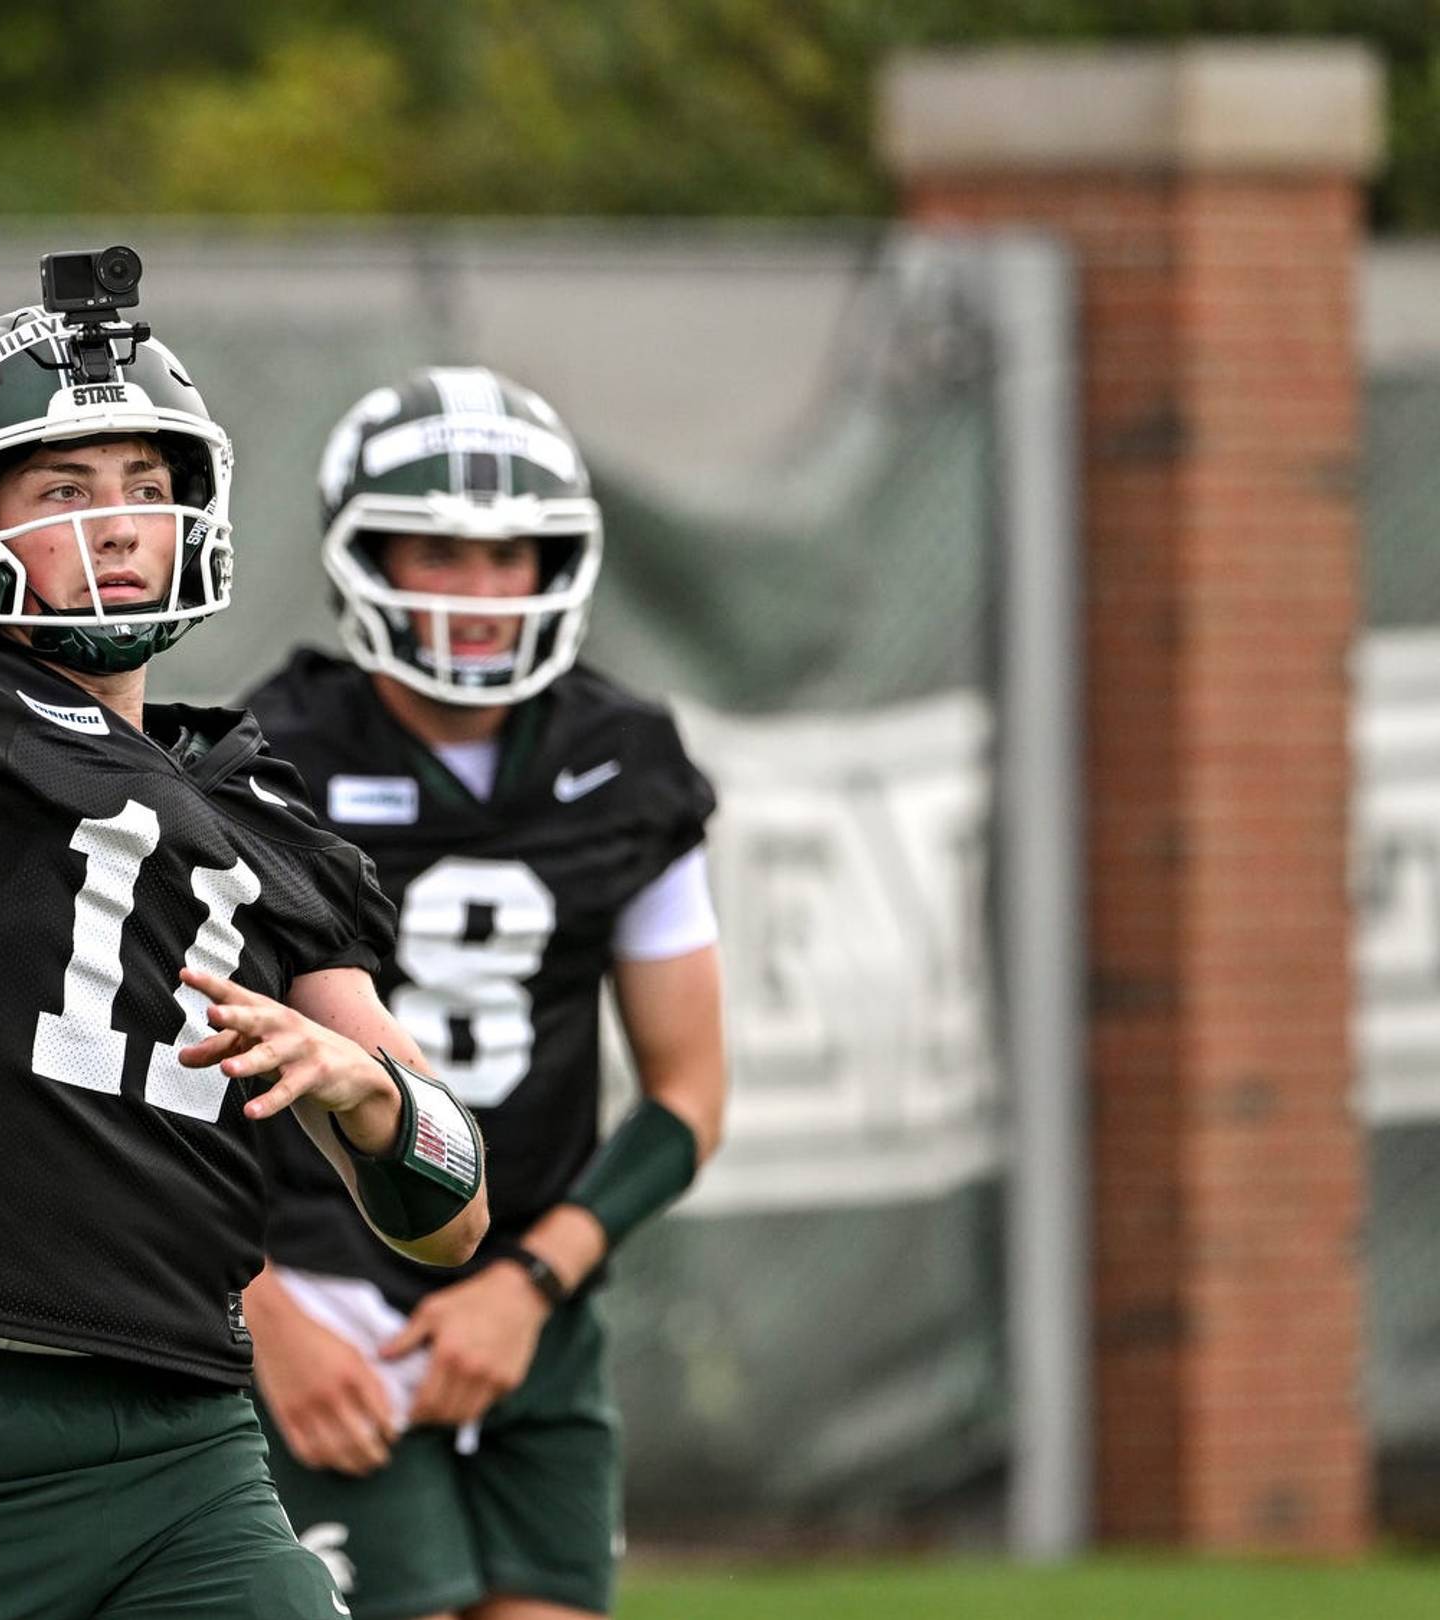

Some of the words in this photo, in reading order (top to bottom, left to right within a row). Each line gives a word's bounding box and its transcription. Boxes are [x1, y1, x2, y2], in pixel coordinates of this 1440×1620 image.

[72, 385, 128, 406] STATE
[32, 799, 261, 1123] 11
[389, 855, 557, 1108] 8
